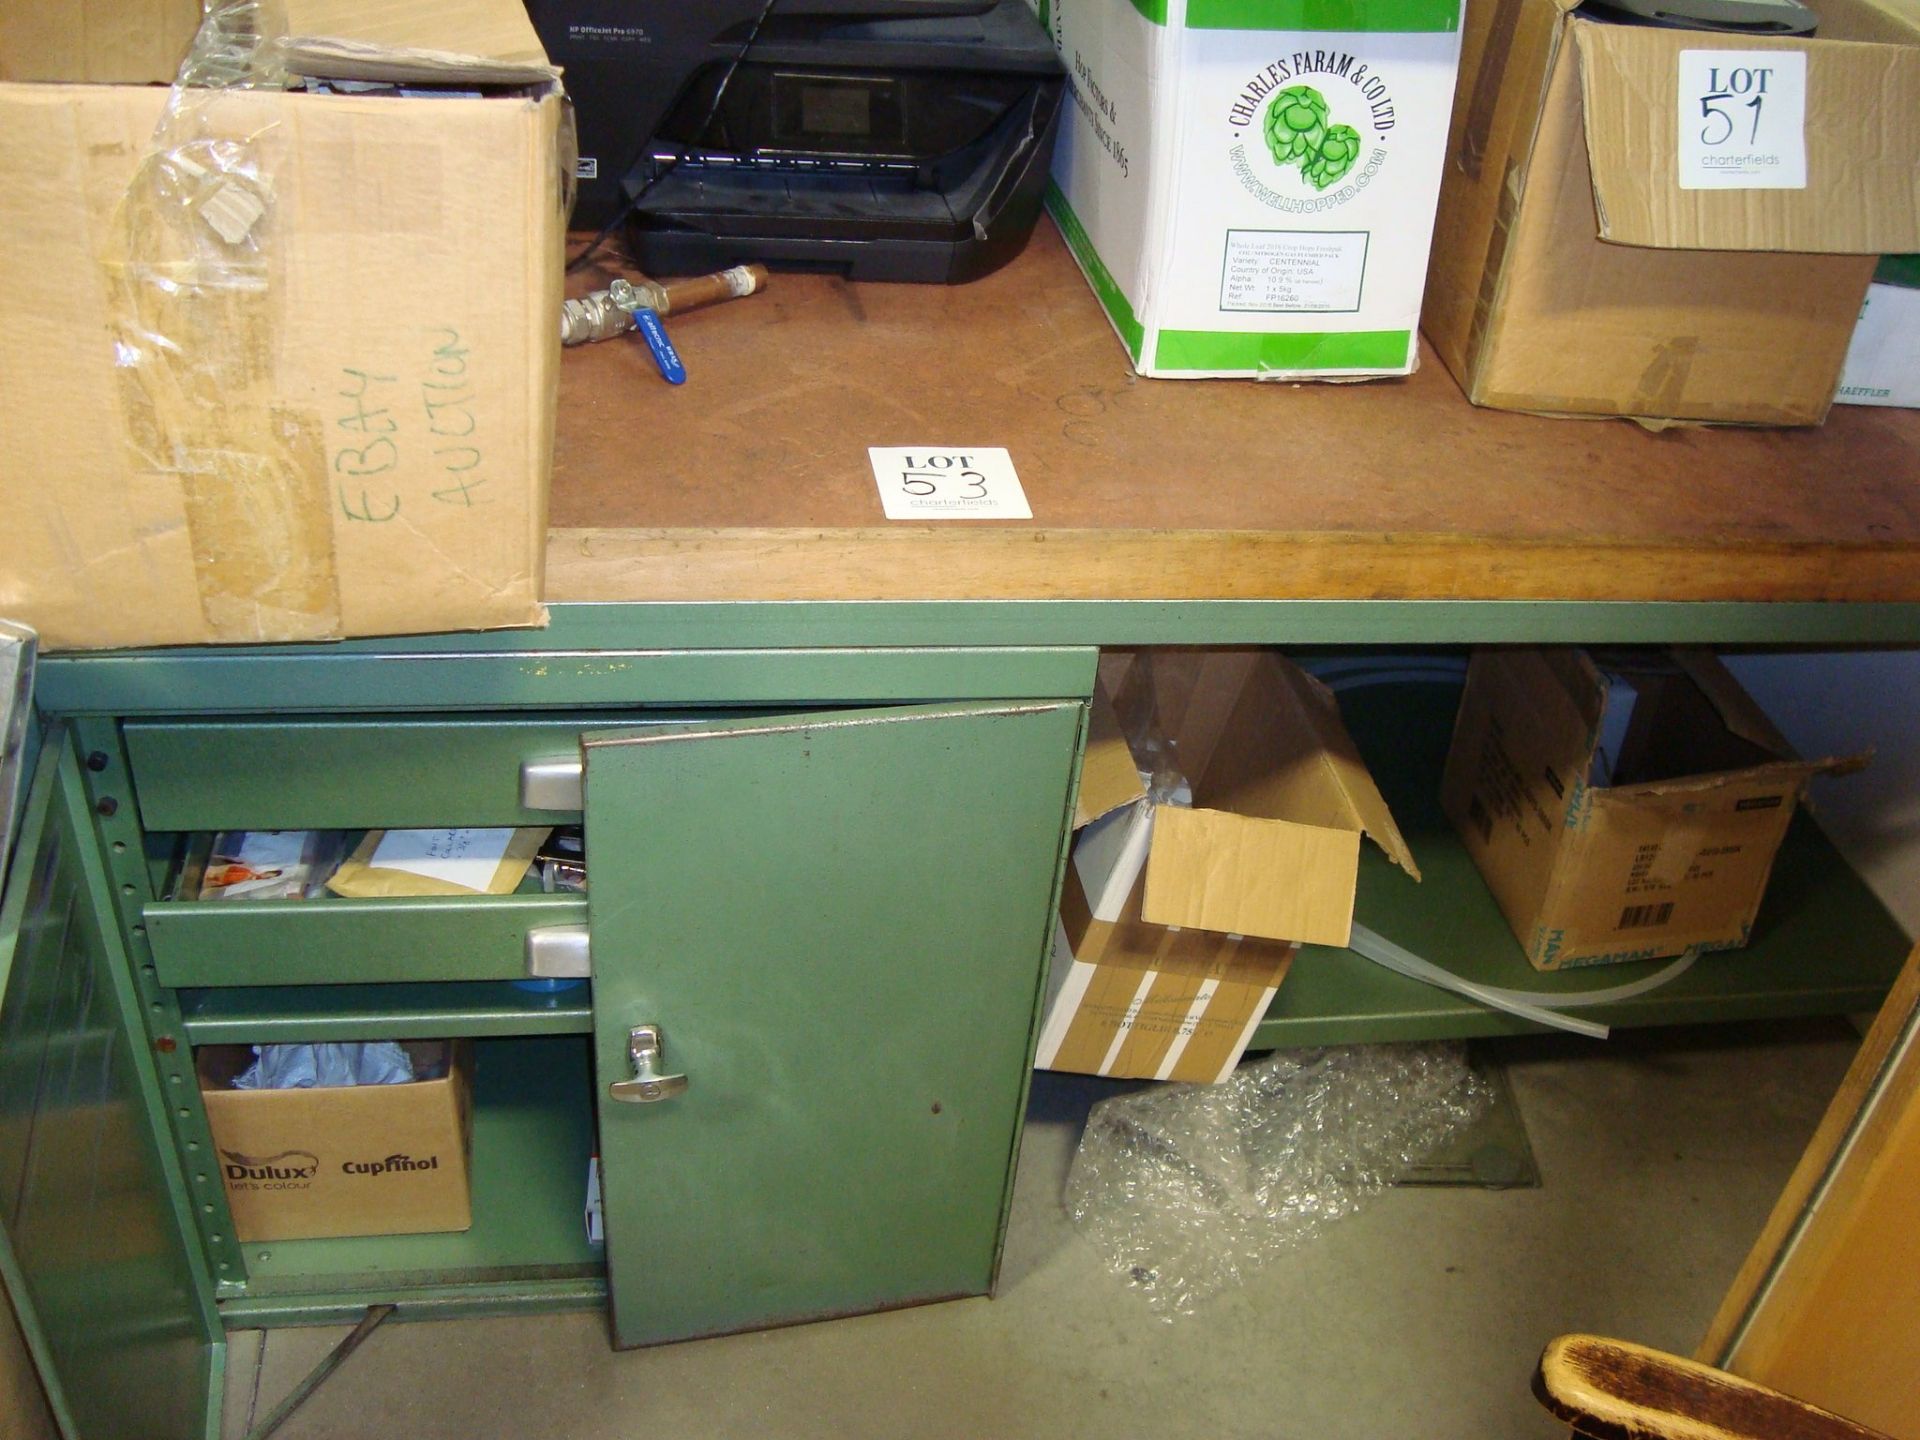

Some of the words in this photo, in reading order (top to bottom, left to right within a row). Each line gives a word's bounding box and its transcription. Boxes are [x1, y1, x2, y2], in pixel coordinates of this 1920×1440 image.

[580, 26, 612, 34] OfficeJet
[1292, 50, 1356, 78] FARAM
[1350, 64, 1368, 86] &
[1361, 76, 1386, 101] CO
[1708, 67, 1774, 94] LOT
[1229, 59, 1292, 127] CHARLES
[1370, 98, 1395, 131] LTD
[1699, 93, 1763, 146] 51
[1112, 141, 1129, 178] 1865
[1701, 154, 1780, 166] charterfields
[1229, 144, 1388, 214] WWW.WELLHOPPED.COM
[1230, 265, 1259, 275] Country
[1269, 257, 1320, 267] CENTENNIAL
[1265, 294, 1300, 302] FP16260
[422, 327, 490, 508] AUCTION
[335, 367, 400, 522] EBAY
[903, 455, 975, 469] LOT
[909, 499, 999, 507] charterfields
[225, 1164, 309, 1180] Dulux
[341, 1154, 438, 1177] Cuprinol
[230, 1182, 260, 1191] let's
[263, 1181, 312, 1190] colour
